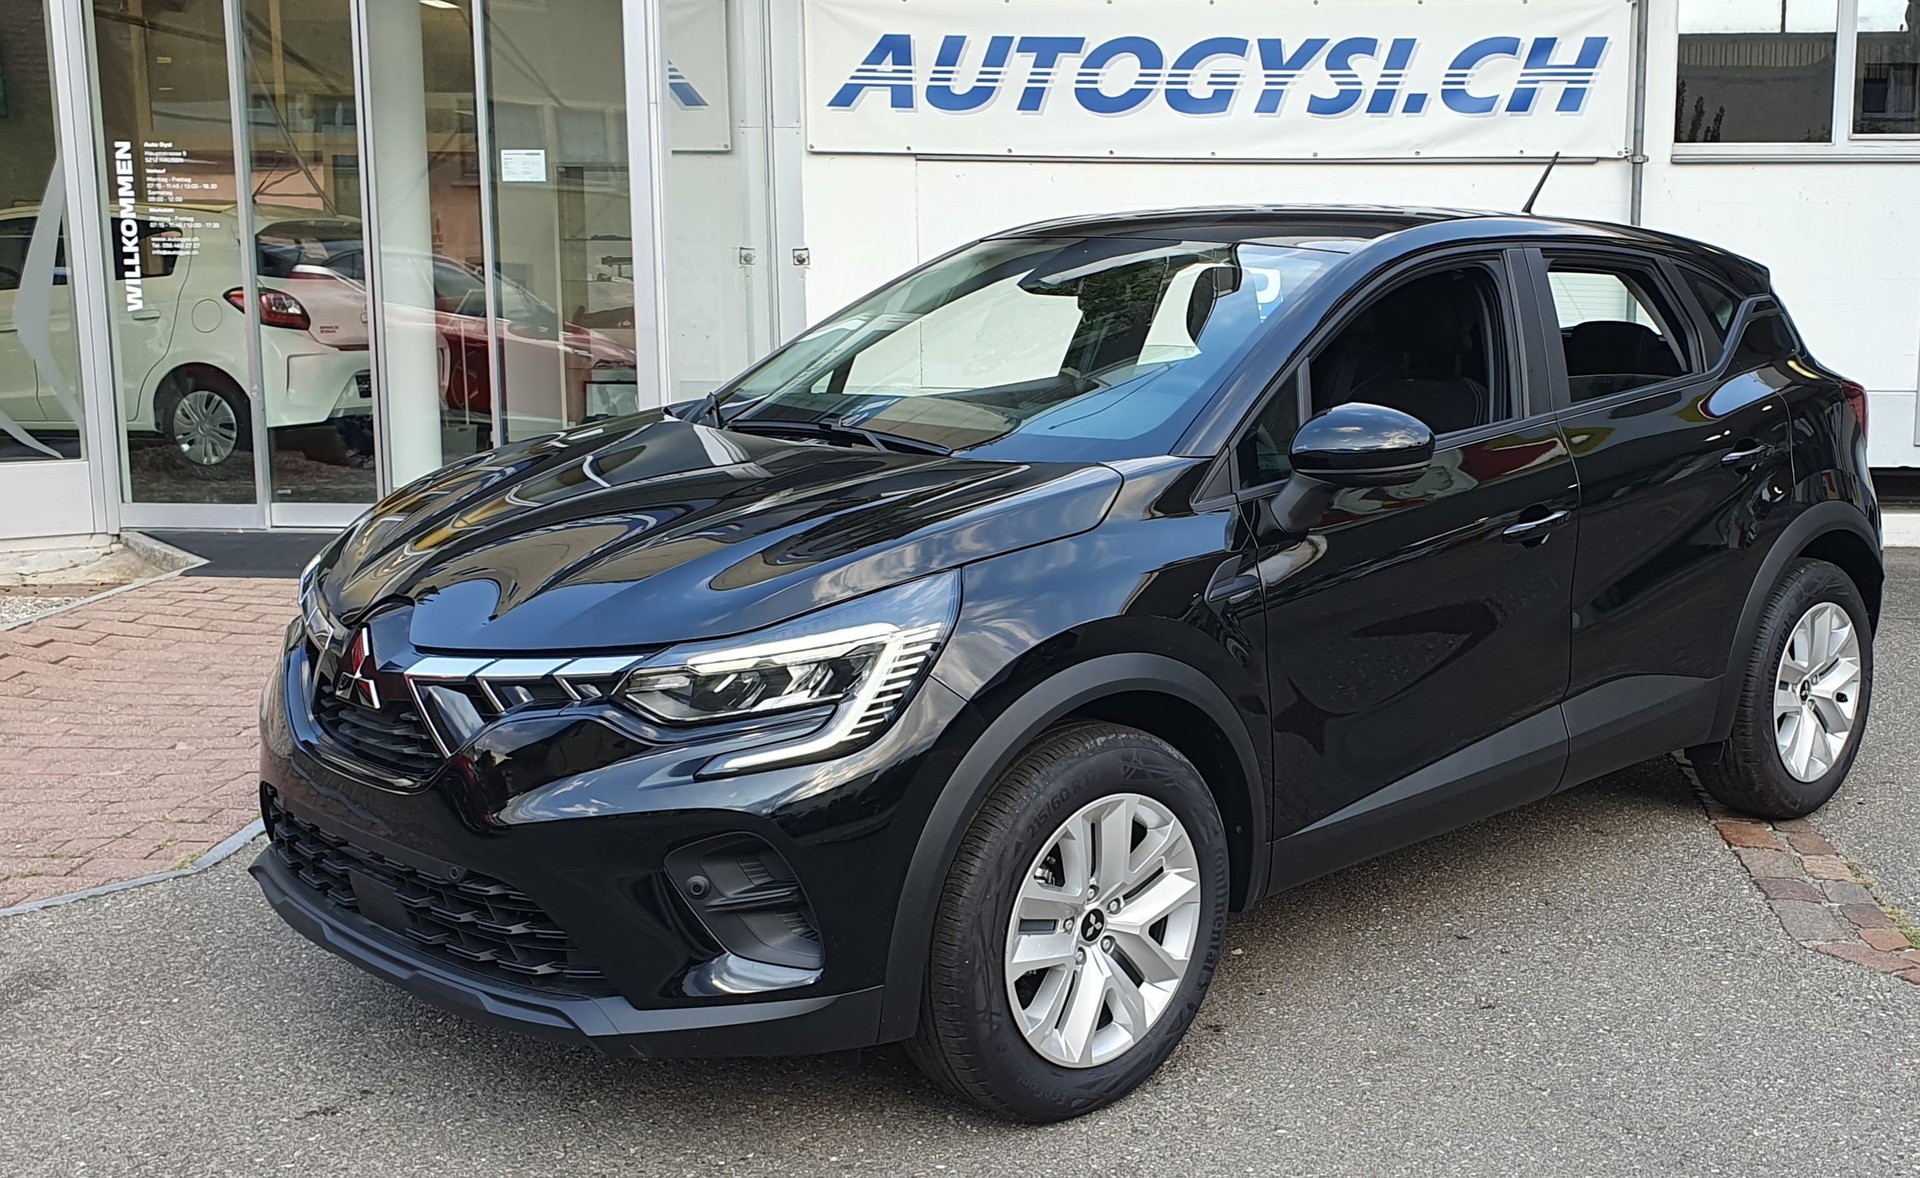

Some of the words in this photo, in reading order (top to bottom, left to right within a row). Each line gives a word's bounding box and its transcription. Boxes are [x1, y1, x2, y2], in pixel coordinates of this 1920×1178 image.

[826, 33, 1611, 118] AUTOGYSI.CH
[114, 140, 144, 312] WILLKOMMEN
[1026, 787, 1071, 838] 215/60
